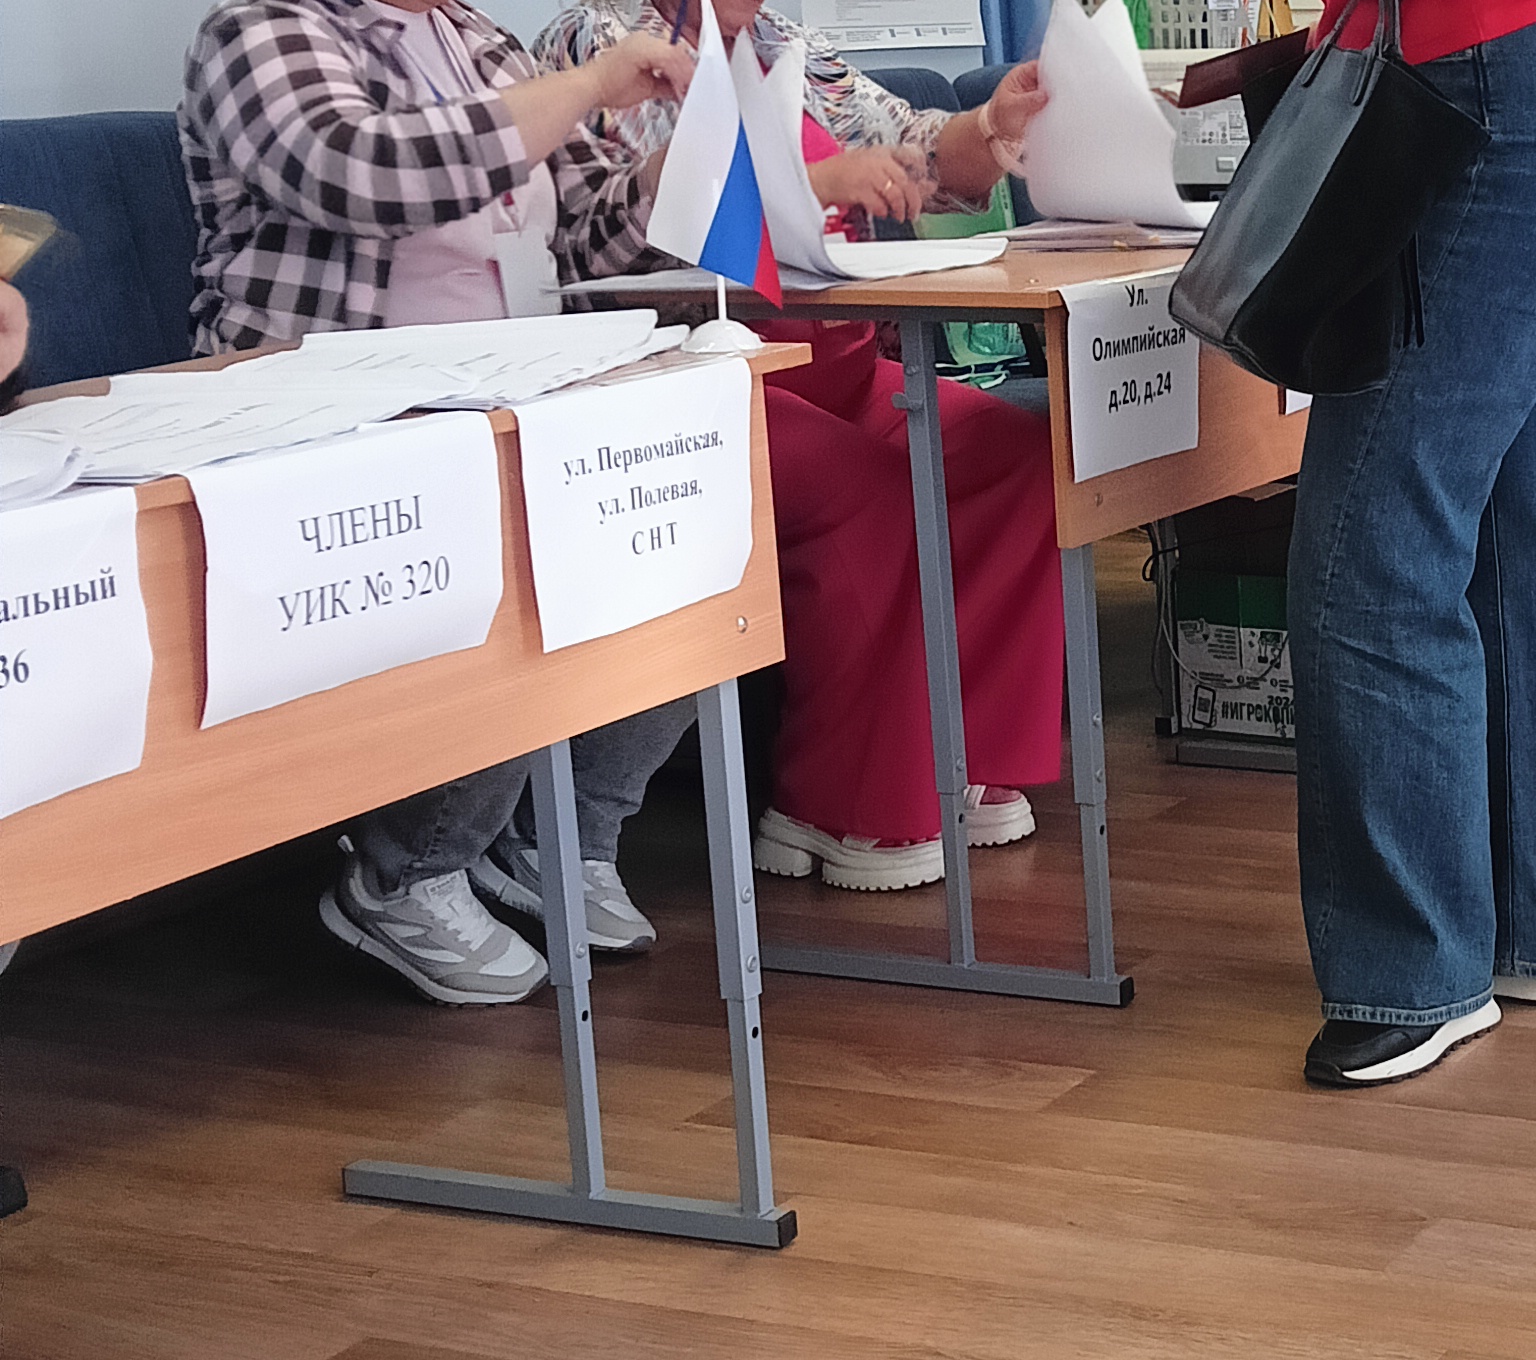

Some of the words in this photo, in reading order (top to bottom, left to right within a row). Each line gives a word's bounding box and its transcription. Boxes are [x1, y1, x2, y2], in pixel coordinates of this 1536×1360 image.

[1124, 284, 1149, 308] Ул.
[1091, 325, 1186, 362] Олимпийская
[1108, 379, 1141, 414] д.20,
[1143, 370, 1172, 406] д.24
[563, 457, 593, 486] ул.
[597, 430, 724, 474] Первомайская,
[297, 494, 423, 554] ЧЛЕНЫ
[597, 497, 626, 525] ул.
[630, 479, 703, 510] Полевая,
[277, 578, 352, 632] УИК
[360, 571, 394, 611] №
[401, 555, 450, 601] 320
